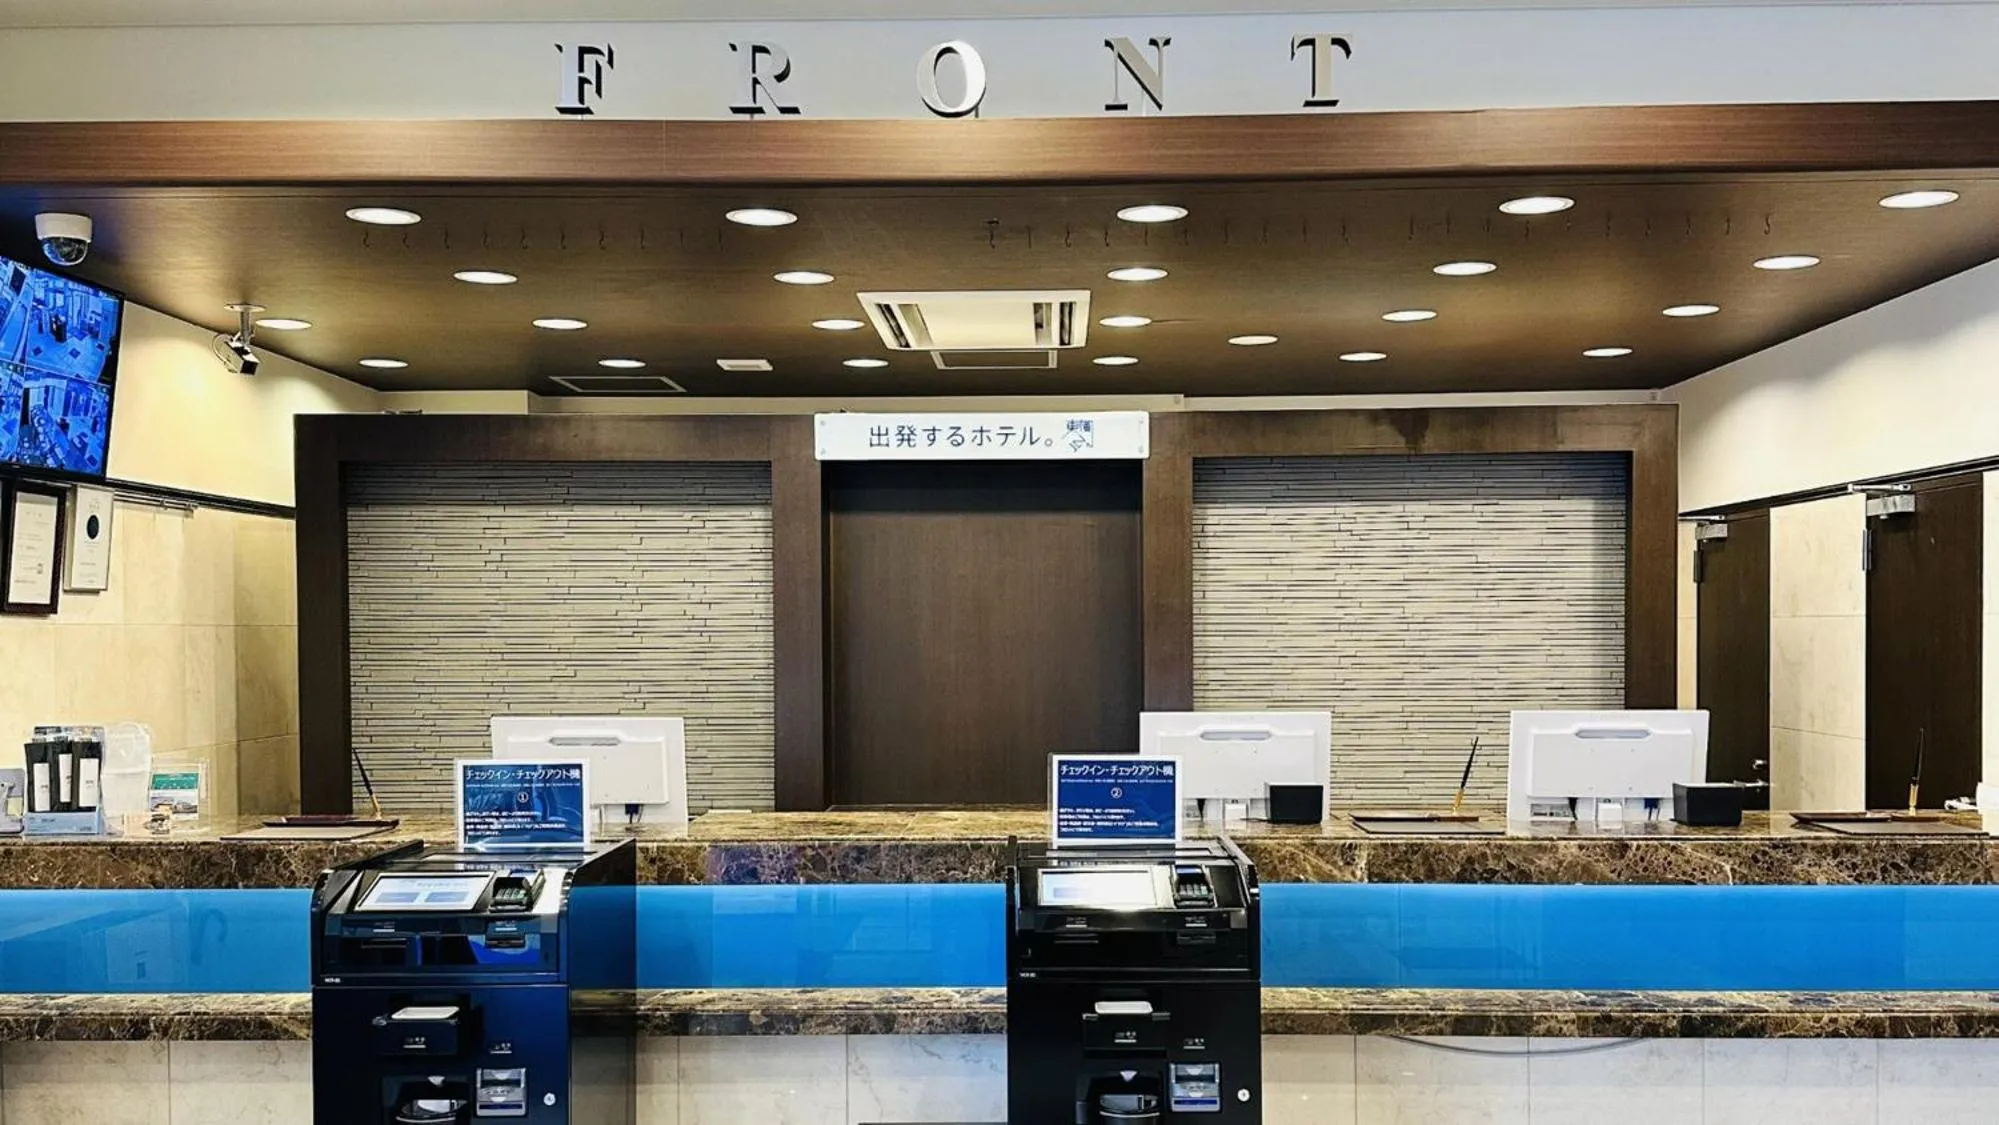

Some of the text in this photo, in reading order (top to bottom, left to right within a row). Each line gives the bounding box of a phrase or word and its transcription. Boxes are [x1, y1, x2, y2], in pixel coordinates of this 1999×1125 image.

[555, 33, 1352, 117] FRONT
[869, 424, 1054, 449] 出発するホテル。
